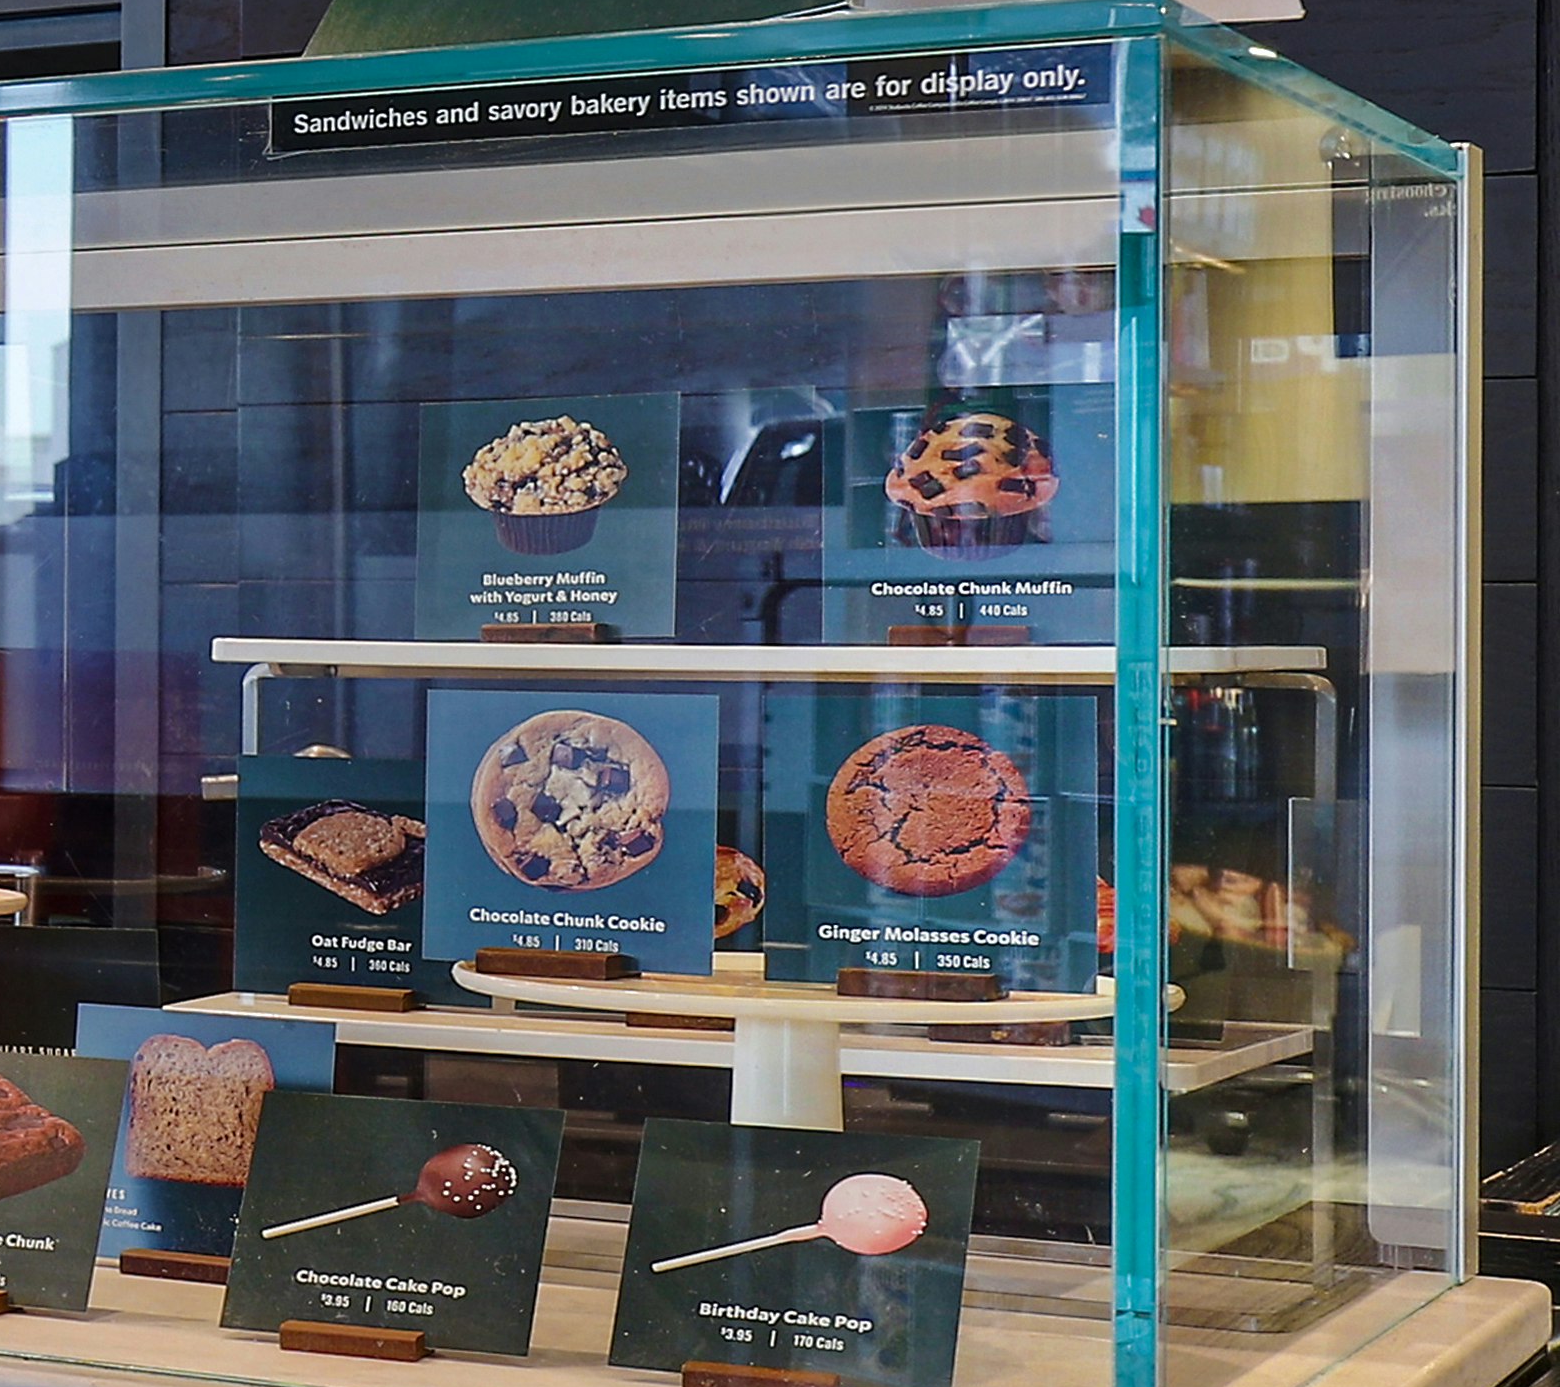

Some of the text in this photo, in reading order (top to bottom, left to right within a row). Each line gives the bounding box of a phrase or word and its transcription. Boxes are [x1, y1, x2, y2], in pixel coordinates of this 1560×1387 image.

[294, 108, 429, 136] Sandwiches
[435, 103, 480, 126] and
[487, 98, 563, 127] savory
[570, 90, 651, 122] bakery
[659, 86, 729, 112] items
[736, 82, 816, 107] shown
[825, 78, 867, 100] are
[875, 73, 911, 96] for
[920, 67, 1015, 100] display
[1022, 62, 1086, 93] only.
[483, 571, 605, 587] Blueberry Muffin
[871, 581, 1073, 596] Chocolate Chunk Muffin
[470, 590, 617, 605] with Yogurt & Honey
[469, 908, 666, 932] Chocolate Chunk Cookie
[311, 935, 412, 953] Oat Fudge Bar
[818, 925, 1039, 946] Ginger Molasses Cookie
[6, 1233, 55, 1252] Chunk
[296, 1270, 466, 1298] Chocolate Cake Pop
[321, 1294, 433, 1315] $3.95 160 Cals
[699, 1302, 872, 1332] Birthday Cake Pop
[721, 1327, 844, 1351] $3.95 170 Cals
